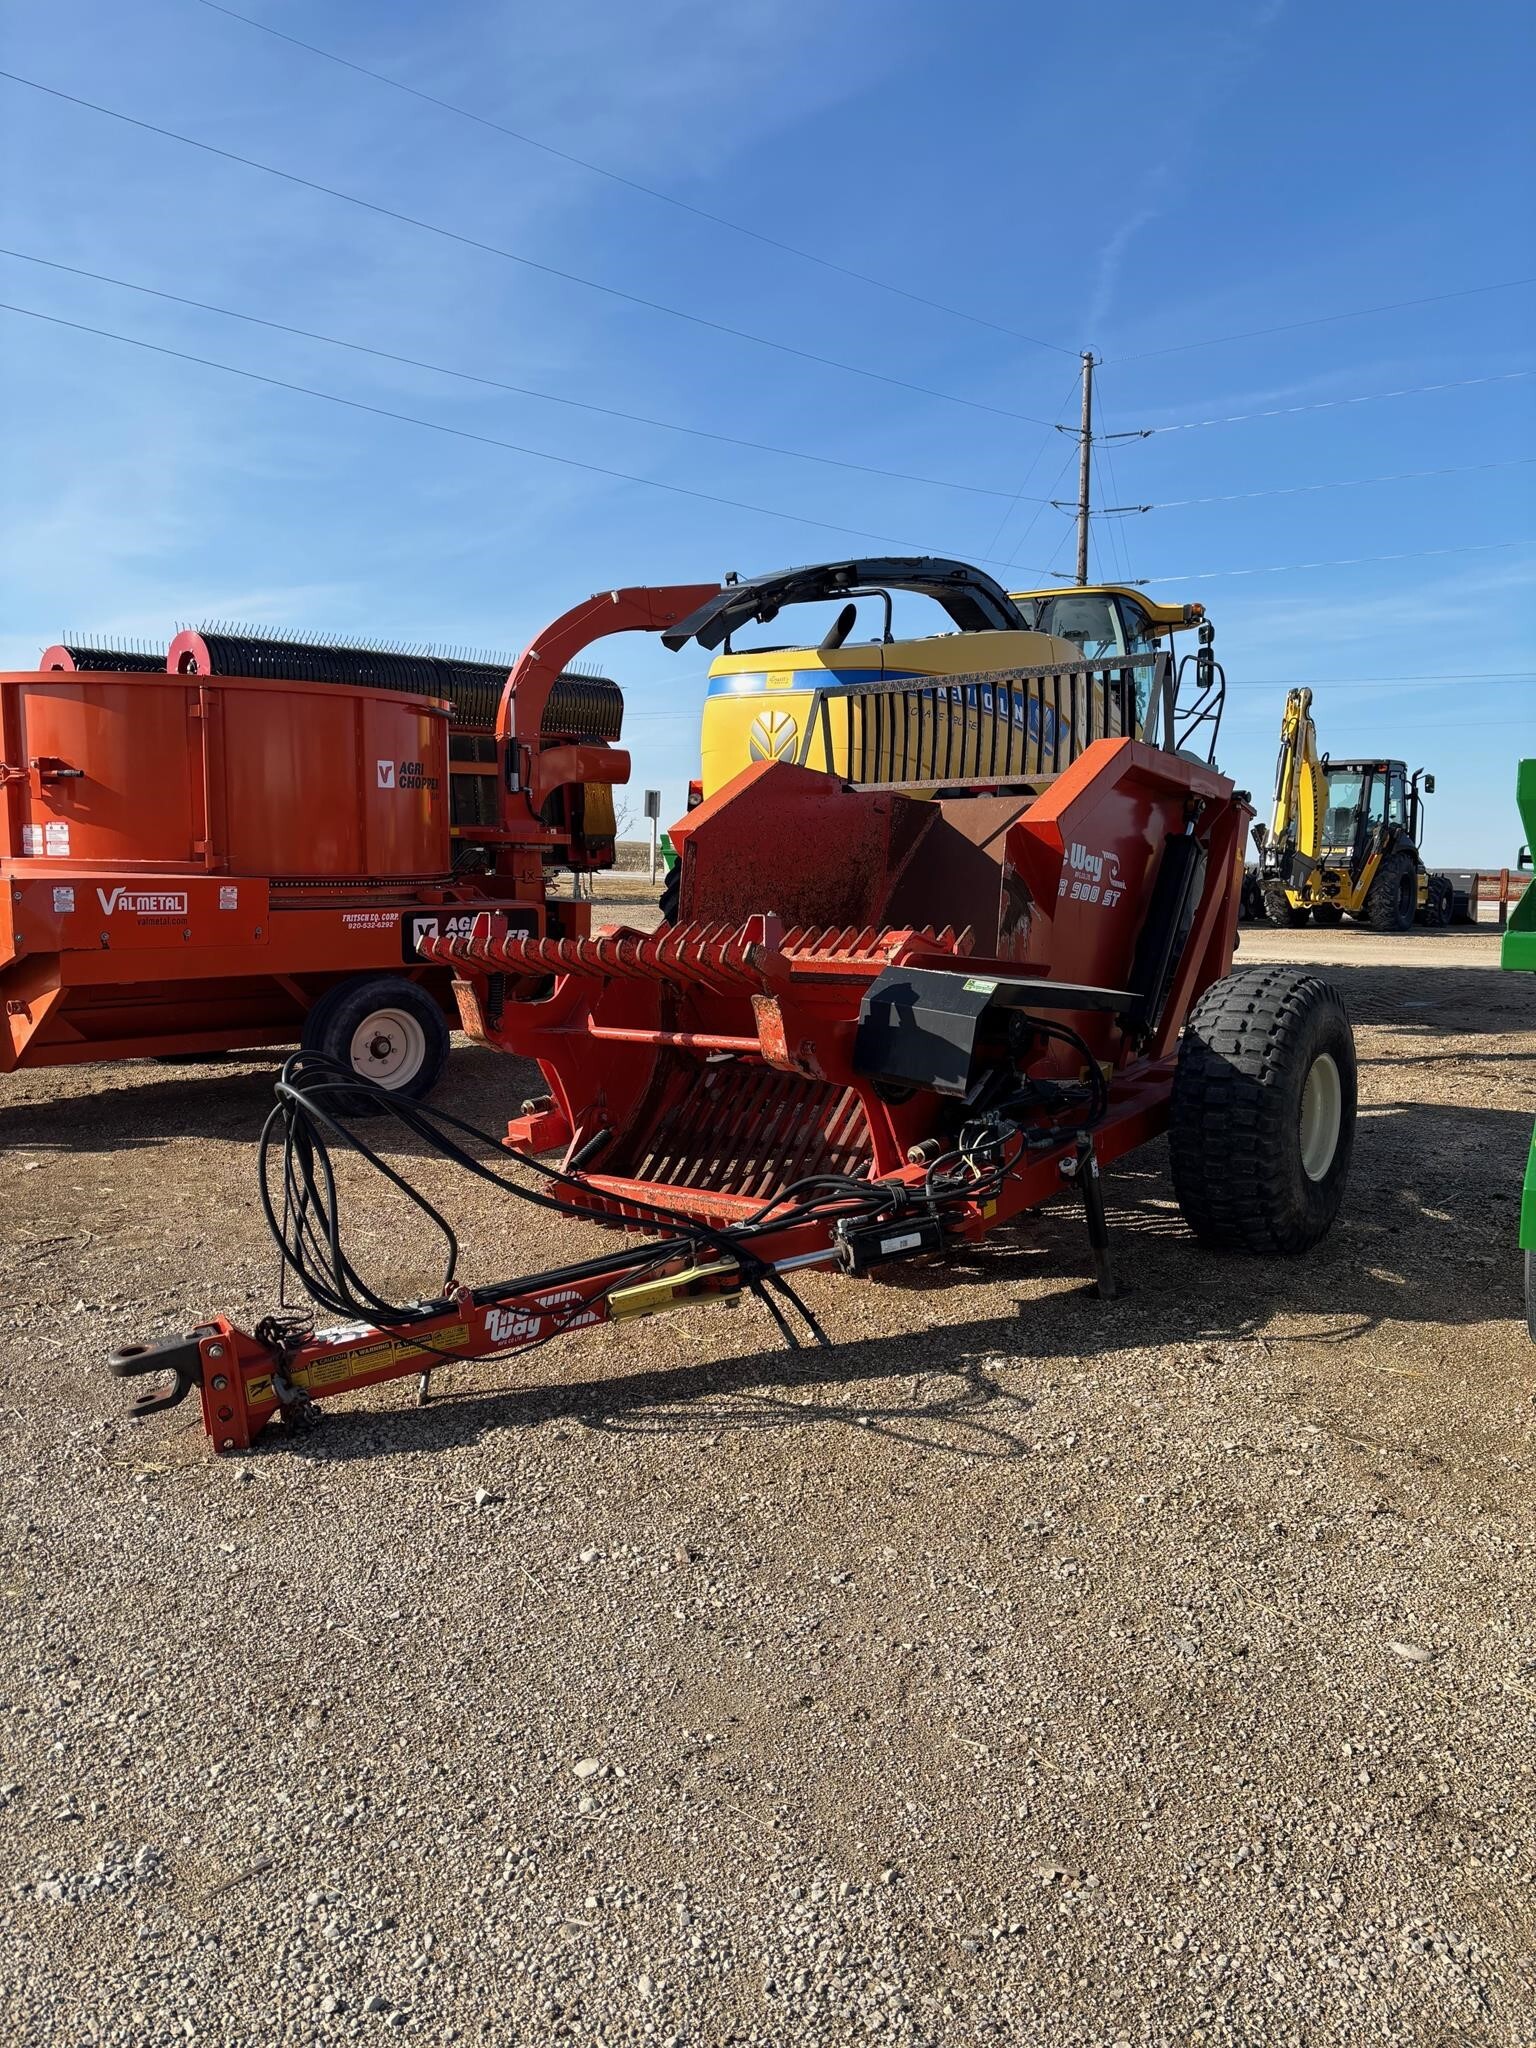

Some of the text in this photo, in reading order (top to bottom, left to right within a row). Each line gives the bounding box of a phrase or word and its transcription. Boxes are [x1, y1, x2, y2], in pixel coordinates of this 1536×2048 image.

[400, 762, 424, 775] AGRI
[1070, 843, 1103, 882] Way
[97, 886, 182, 916] VALMETAL
[1070, 882, 1100, 903] 900
[1102, 890, 1121, 907] ST
[137, 917, 188, 926] valmetal.com
[342, 914, 370, 922] FRITSCH
[382, 913, 399, 921] CORP.
[403, 1334, 432, 1346] WRNING
[359, 1343, 390, 1356] WARNING
[319, 1353, 348, 1365] CAUTION
